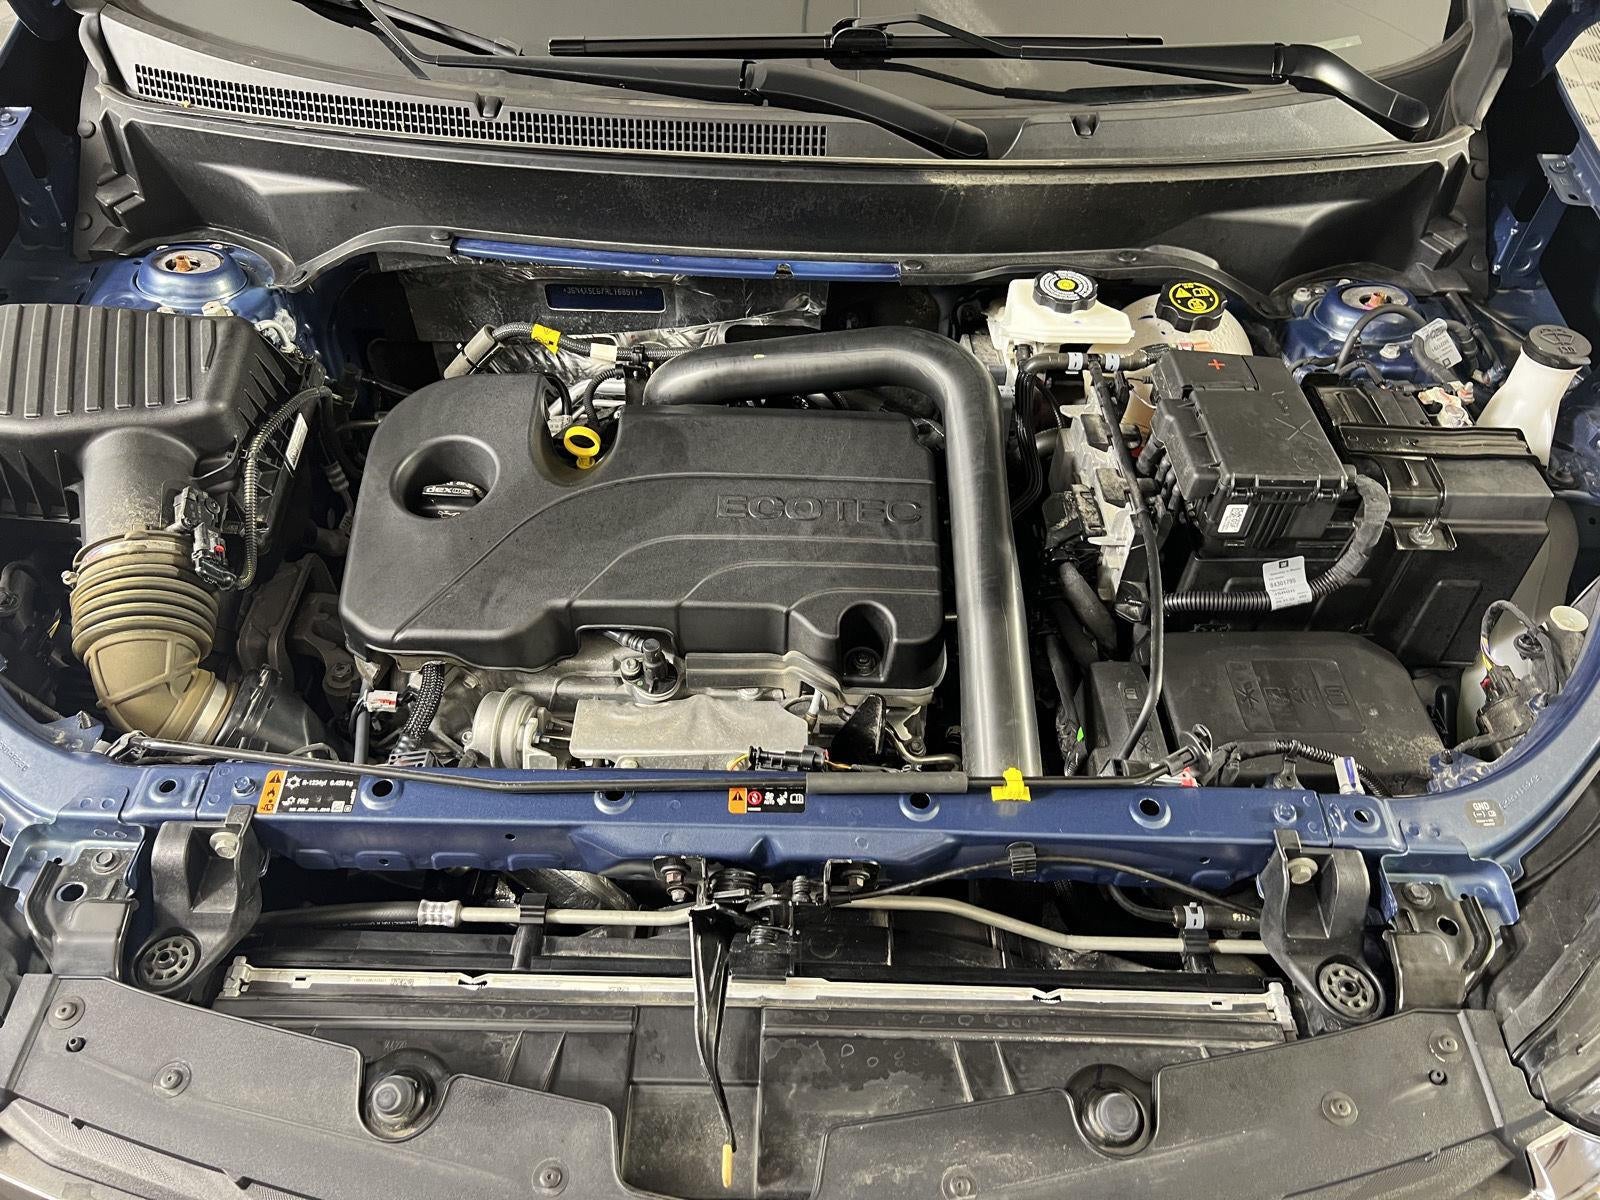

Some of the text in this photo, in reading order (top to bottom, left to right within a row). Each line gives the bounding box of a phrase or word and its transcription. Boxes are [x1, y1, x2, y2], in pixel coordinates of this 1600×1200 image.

[425, 485, 471, 495] dexos
[716, 495, 923, 524] ECOTEC
[1472, 801, 1490, 811] GND
